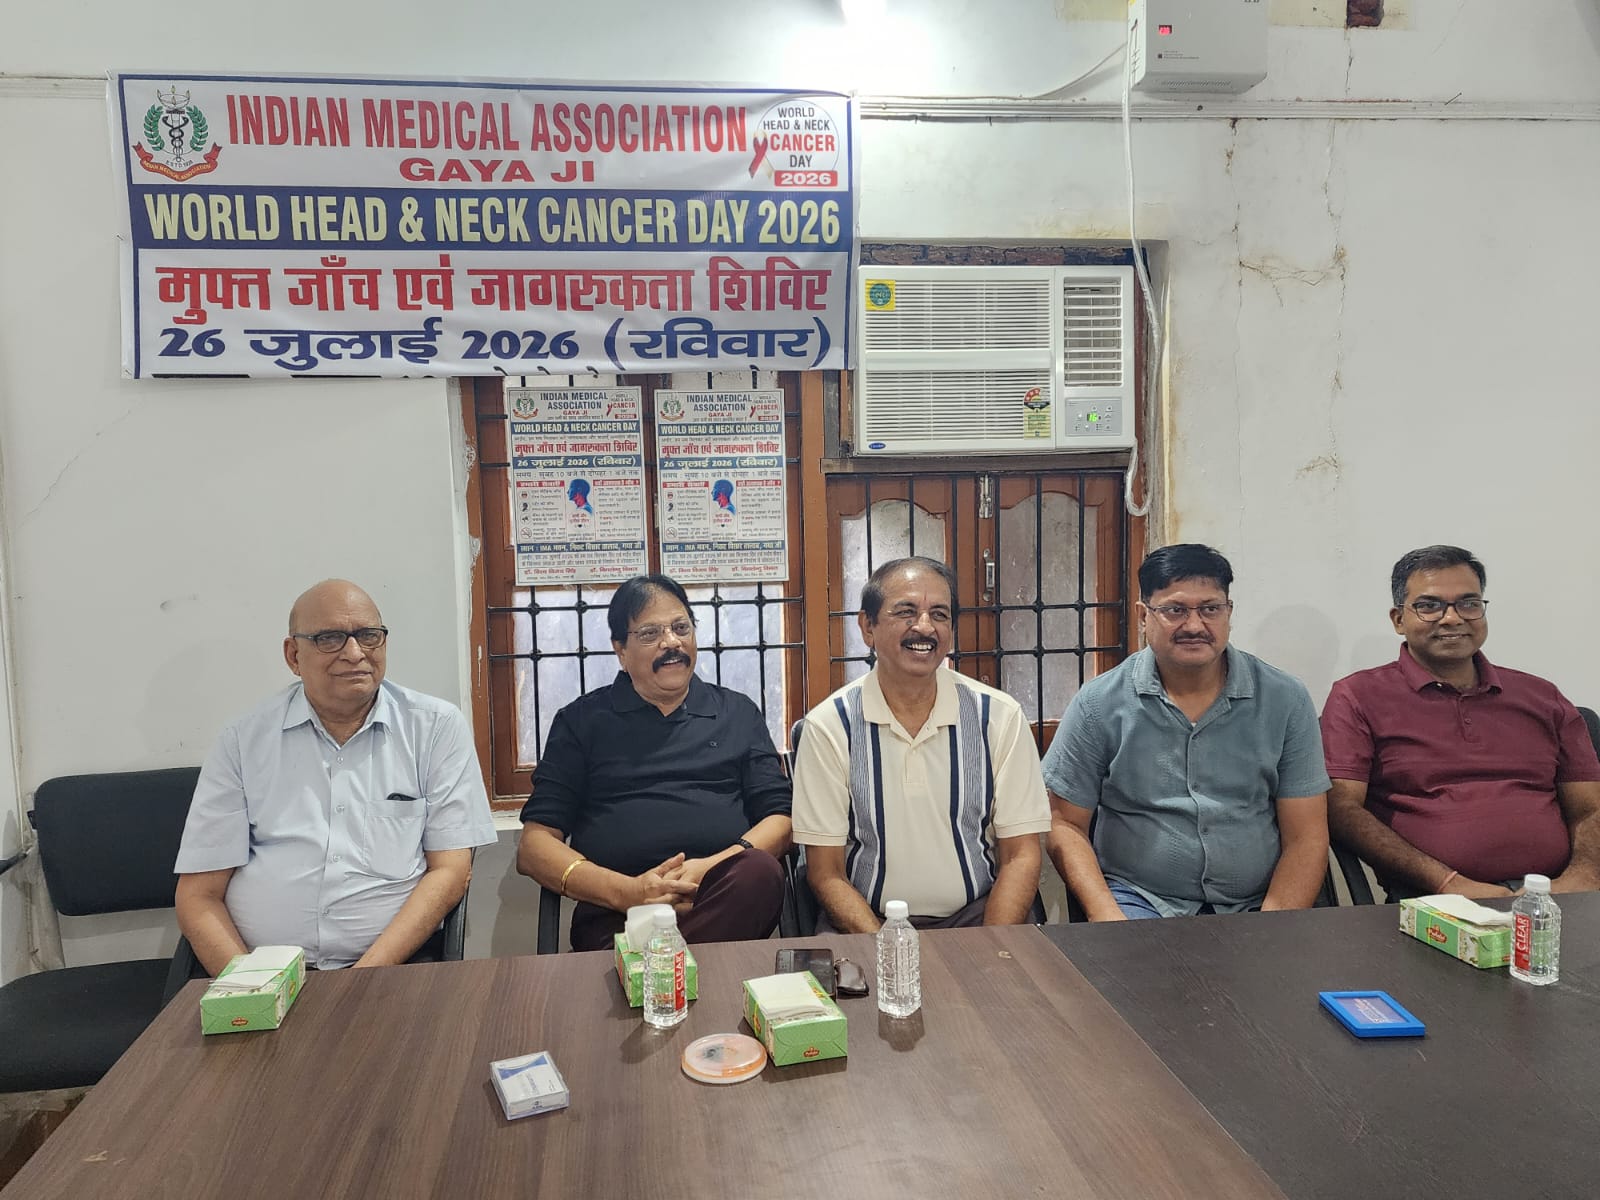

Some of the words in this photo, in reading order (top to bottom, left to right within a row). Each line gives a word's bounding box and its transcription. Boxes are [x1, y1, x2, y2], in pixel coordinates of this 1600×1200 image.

[777, 107, 815, 118] WORLD
[226, 95, 351, 147] INDIAN
[362, 98, 520, 151] MEDICAL
[531, 103, 747, 153] ASSOCIATION
[763, 119, 791, 131] HEAD
[794, 119, 801, 131] &
[804, 119, 830, 131] NECK
[770, 133, 835, 152] CANCER
[789, 154, 812, 168] DAY
[400, 158, 535, 182] GAYA
[551, 160, 594, 182] JI
[781, 172, 832, 185] 2026
[144, 193, 280, 241] WORLD
[290, 195, 387, 241] HEAD
[399, 196, 426, 242] &
[435, 197, 530, 243] NECK
[538, 197, 677, 244] CANCER
[687, 199, 750, 244] DAY
[758, 200, 840, 245] 2026
[155, 266, 271, 325] मुफ्त
[284, 255, 382, 311] जाँच
[393, 254, 454, 311] एवं
[706, 256, 832, 311] शिविर
[158, 327, 226, 357] 26
[244, 317, 443, 370] जुलाई
[461, 330, 580, 360] 2026
[604, 316, 831, 371] (रविवार)
[540, 392, 568, 401] INDIAN
[571, 392, 608, 400] MEDICAL
[686, 394, 713, 403] INDIAN
[716, 394, 752, 402] MEDICAL
[547, 401, 602, 410] ASSOCIATION
[693, 403, 746, 411] ASSOCIATION
[514, 424, 540, 433] WORLD
[542, 423, 562, 432] HEAD
[564, 423, 569, 432] &
[571, 423, 590, 432] NECK
[592, 423, 622, 432] CANCER
[622, 422, 637, 431] DAY
[661, 425, 686, 434] WORLD
[688, 425, 707, 433] HEAD
[709, 425, 714, 433] &
[716, 425, 735, 433] NECK
[736, 424, 765, 433] CANCER
[765, 424, 779, 433] DAY
[556, 441, 567, 453] एवं
[613, 440, 638, 452] शिविर
[701, 442, 712, 454] एवं
[756, 441, 779, 453] शिविर
[531, 457, 564, 469] जुलाई
[592, 456, 636, 467] (रविवार)
[677, 458, 709, 470] जुलाई
[735, 457, 778, 468] (रविवार)
[1516, 916, 1528, 952] CLEAR
